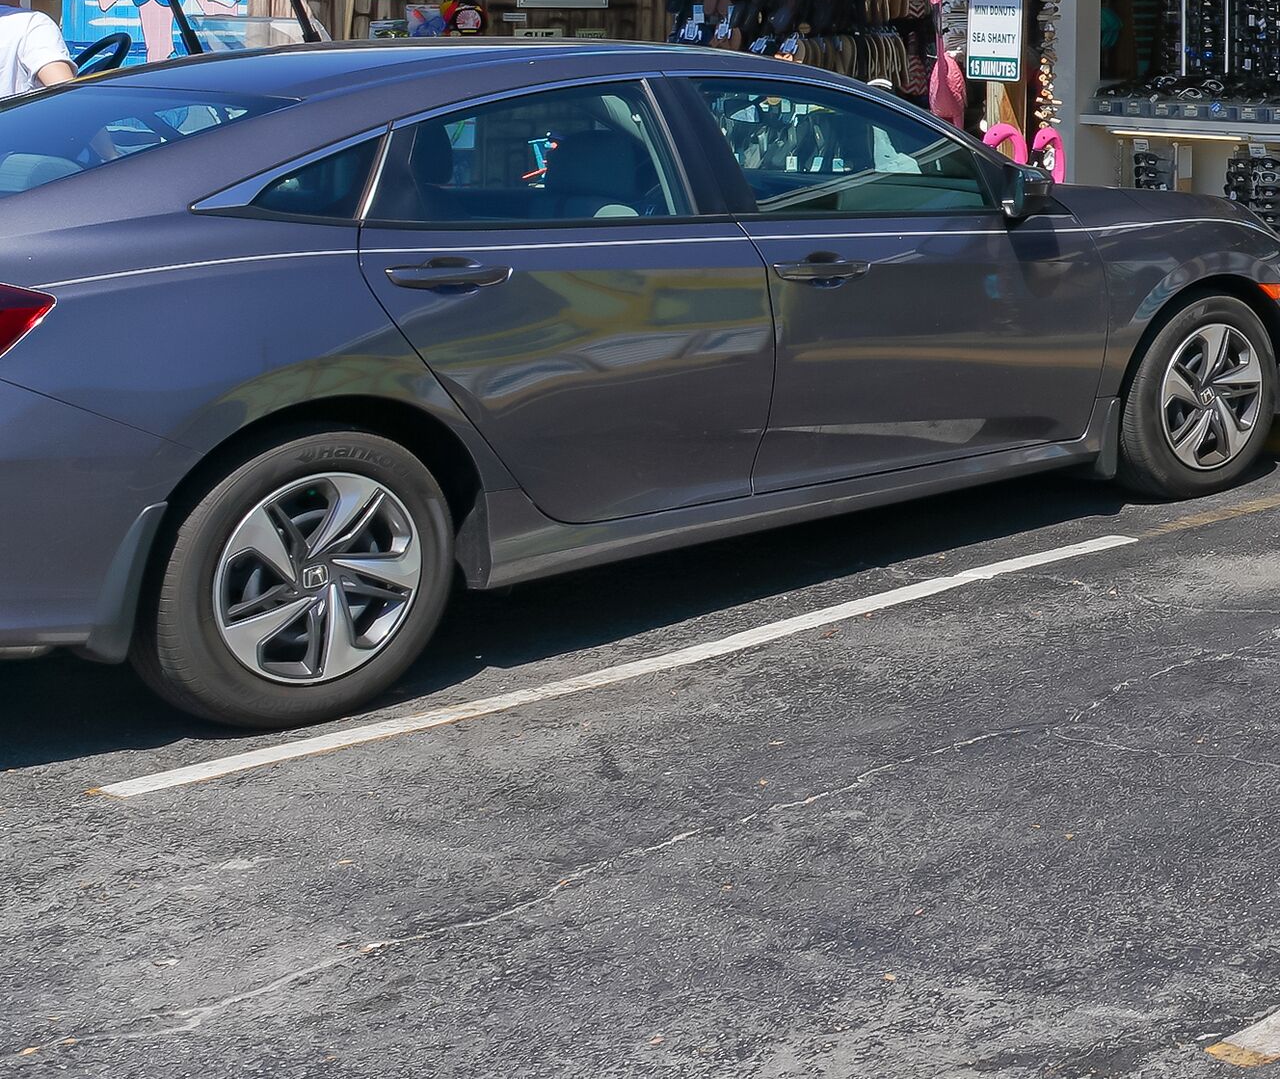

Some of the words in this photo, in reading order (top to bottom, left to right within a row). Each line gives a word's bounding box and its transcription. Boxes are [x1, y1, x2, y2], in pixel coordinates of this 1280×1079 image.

[974, 4, 989, 16] MINI
[990, 5, 1016, 17] DONUTS
[972, 32, 986, 43] SEA
[987, 32, 1017, 44] SHANTY
[970, 59, 980, 76] 15
[981, 60, 1017, 77] MINUTES
